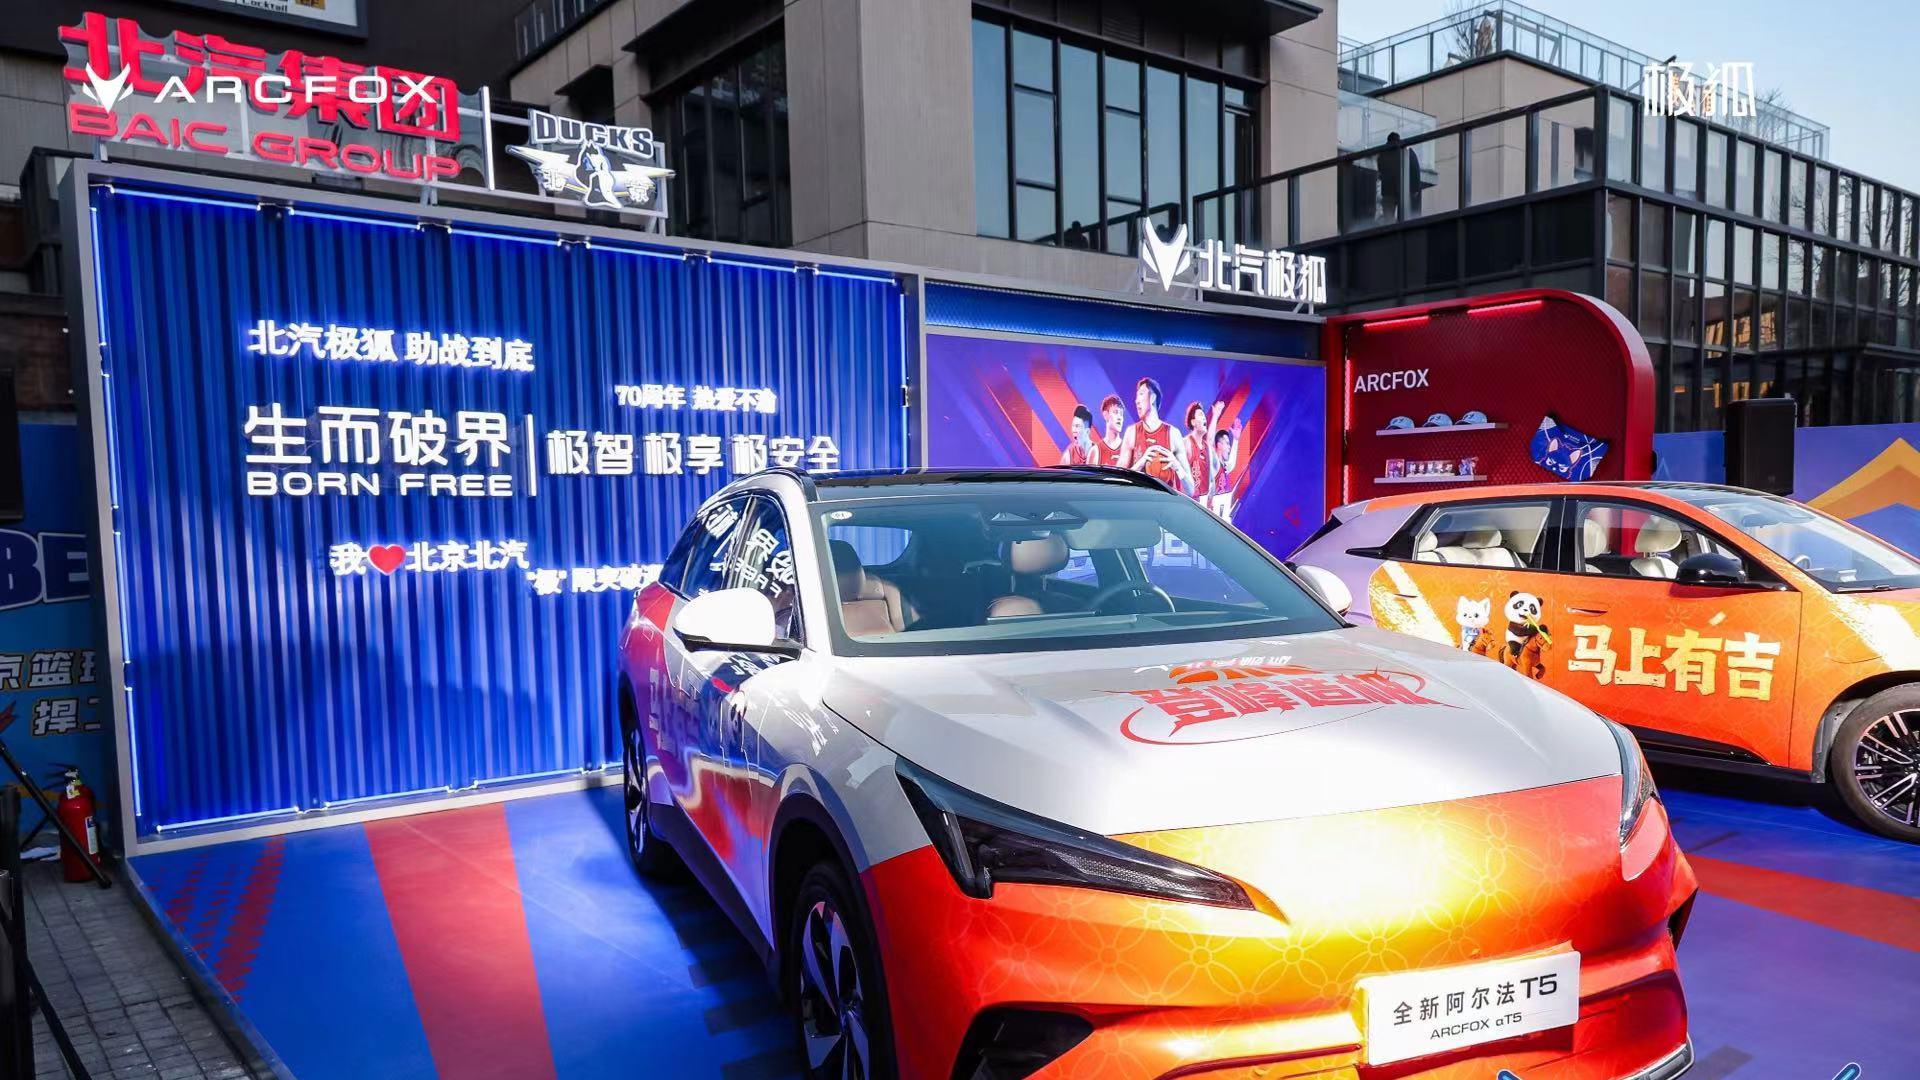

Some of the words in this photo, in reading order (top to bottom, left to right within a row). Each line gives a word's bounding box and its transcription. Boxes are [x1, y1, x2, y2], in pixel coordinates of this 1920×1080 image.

[58, 12, 460, 142] 北汽集团
[70, 103, 229, 154] BAIC
[252, 132, 462, 181] GROUP
[531, 110, 653, 158] DUCKS
[1198, 238, 1327, 304] 北汽极狐
[247, 319, 398, 362] 北汽极狐
[405, 331, 535, 372] 助战到底
[614, 384, 687, 410] 70周年
[1354, 368, 1430, 393] ARCFOX
[244, 402, 511, 467] 生而破界
[546, 430, 635, 475] 极智
[643, 432, 724, 475] 极享
[732, 433, 841, 475] 极安全
[247, 471, 380, 496] BORN
[400, 473, 513, 497] FREE
[405, 539, 529, 573] 北京北汽
[1568, 624, 1781, 701] 马上有吉
[34, 698, 101, 737] 捍
[1430, 1018, 1490, 1040] ARCFOX
